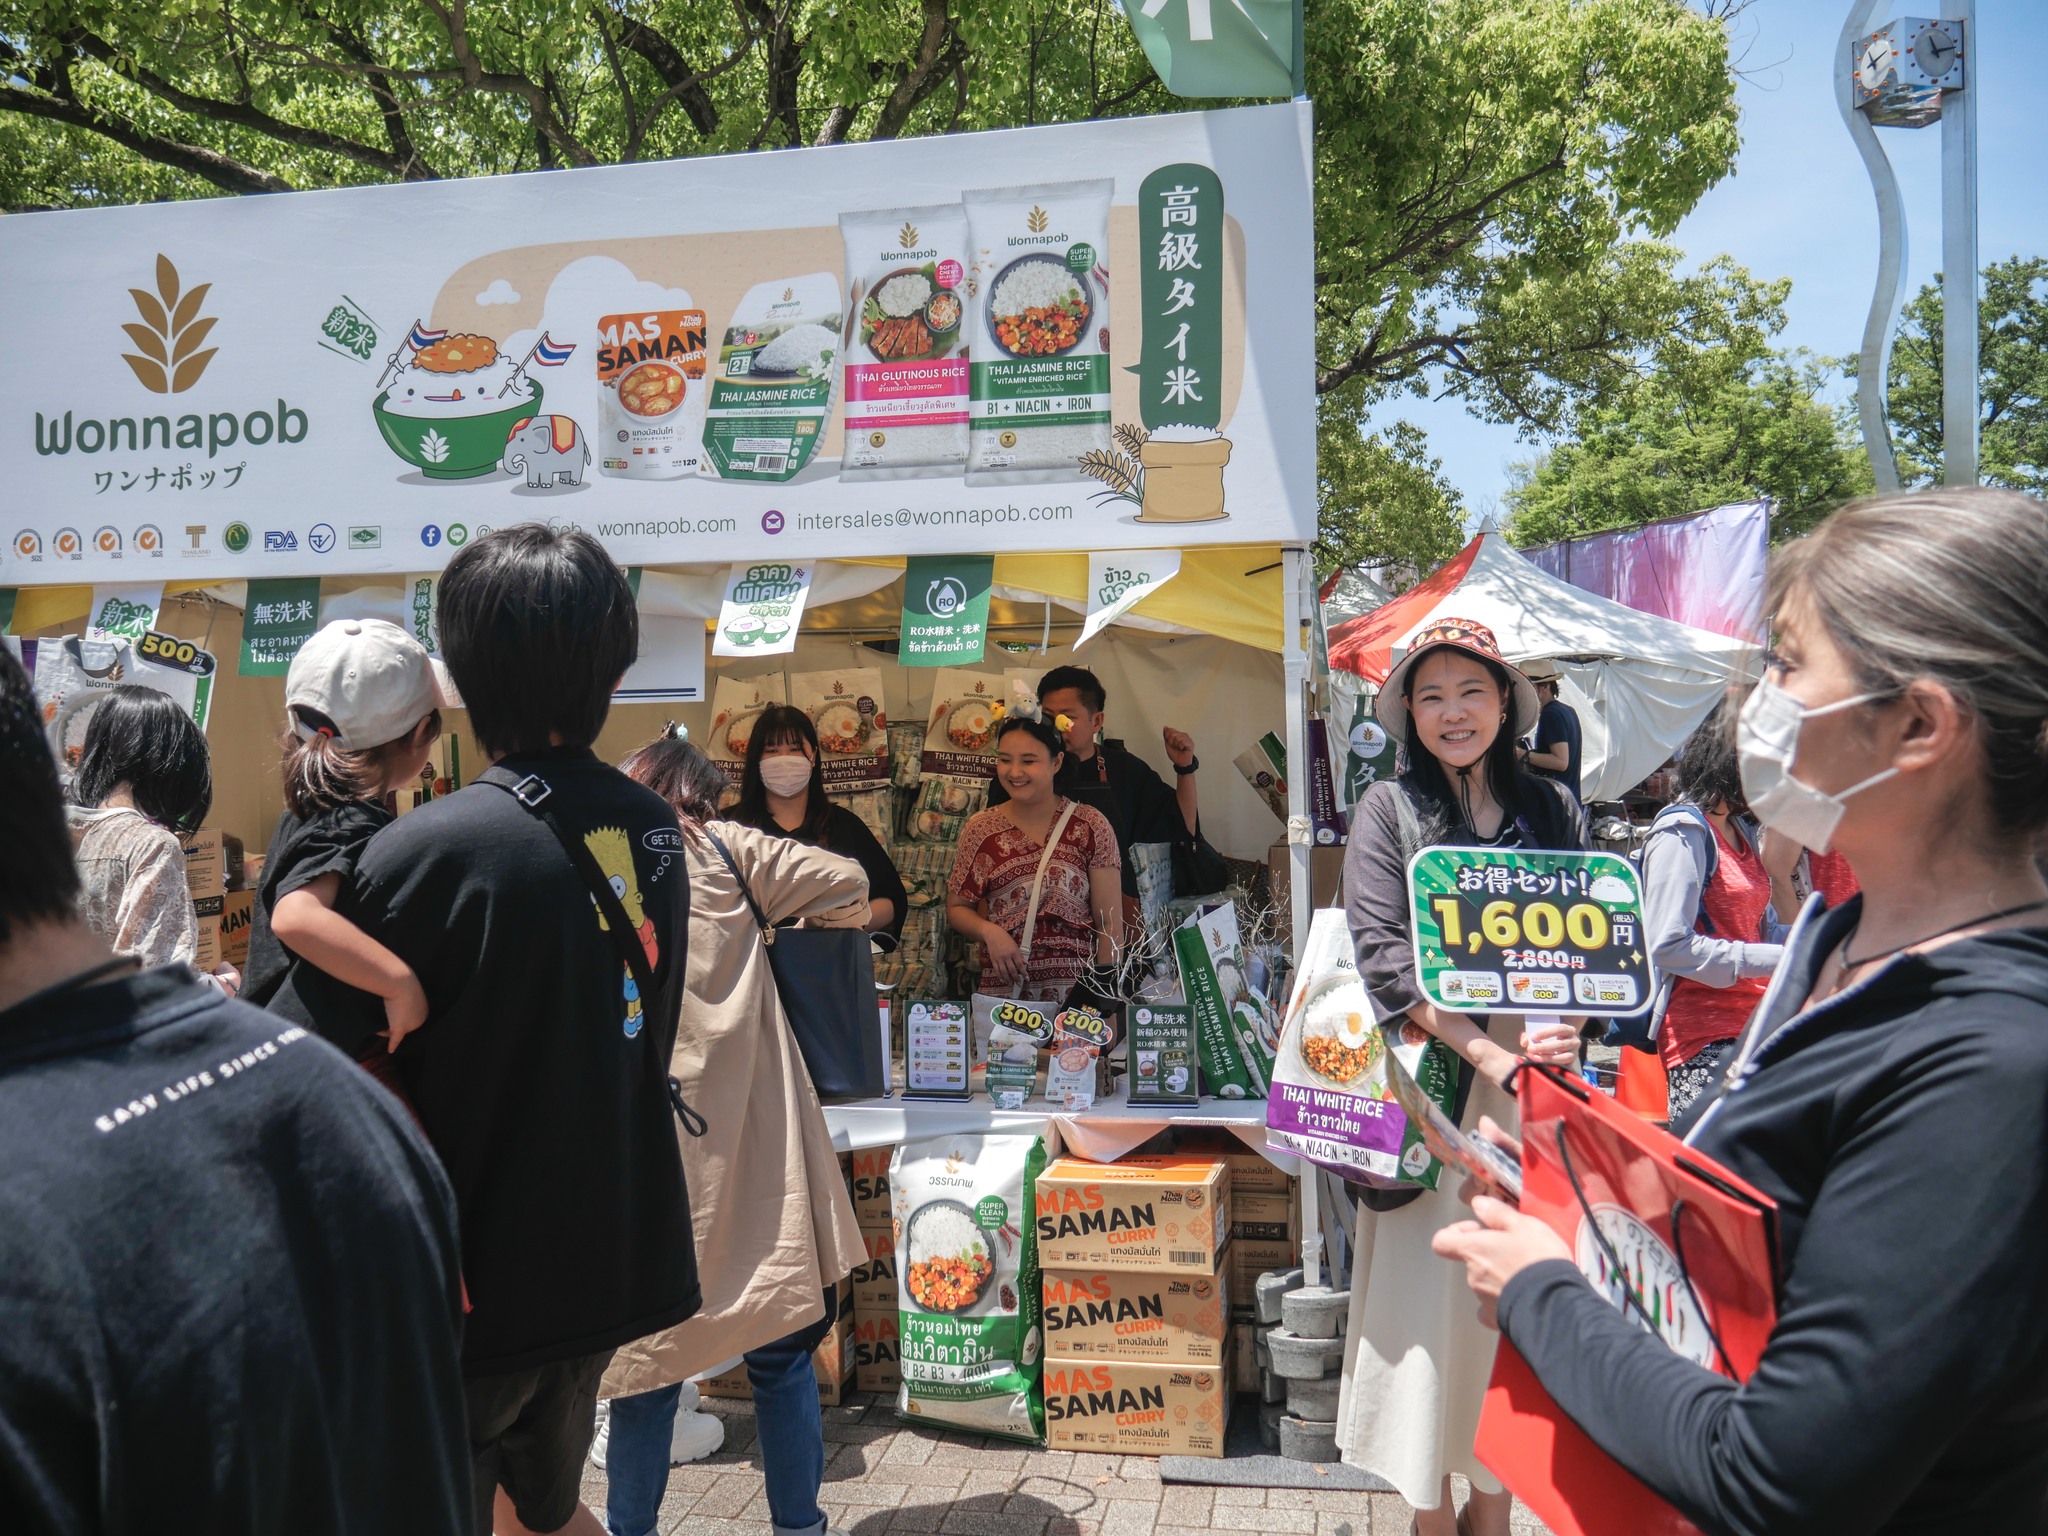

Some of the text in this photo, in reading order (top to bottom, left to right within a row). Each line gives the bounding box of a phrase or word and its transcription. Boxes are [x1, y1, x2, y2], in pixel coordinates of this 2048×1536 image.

[1007, 232, 1069, 247] Wonnapob
[880, 249, 938, 261] Wonnapob
[1069, 247, 1093, 256] SUPER
[1158, 185, 1203, 405] 高級タイ米
[321, 305, 377, 361] 新米
[597, 315, 661, 350] MAS
[597, 327, 706, 372] SAMAN
[669, 350, 706, 365] CURRY
[732, 360, 741, 372] 2
[988, 360, 1091, 376] THAI JASMINE RICE
[855, 367, 965, 383] THAI GLUTINOUS RICE
[1028, 375, 1065, 383] ENRICHED
[720, 388, 817, 403] THAI JASMINE RICE
[987, 397, 1092, 415] B1 NIACIN IRON
[36, 398, 309, 458] Wonnapob
[797, 425, 815, 434] 180g
[94, 461, 247, 495] ワンナポップ
[798, 504, 1073, 530] intersales@wonnapob.com
[598, 517, 736, 538] wonnapob.com
[264, 530, 299, 549] FDA
[748, 566, 790, 582] ราคา
[1104, 567, 1132, 584] ข้าว
[734, 583, 800, 603] พิเศษ!
[750, 605, 791, 617] お得です!
[938, 598, 955, 607] RO
[97, 599, 152, 635] 新米
[253, 600, 314, 626] 無洗米
[413, 578, 435, 654] 高級タイ米
[142, 634, 204, 666] 500 円
[966, 640, 979, 650] RO
[823, 693, 855, 701] Wonnapob
[963, 692, 994, 700] Wonnapob
[1352, 740, 1383, 748] Wonnapob
[830, 758, 878, 769] WHITE RICE
[934, 752, 999, 765] THAI WHITE RICE
[823, 768, 866, 779] ข้าวขาวไทย
[945, 763, 987, 774] ข้าวขาวไทย
[832, 781, 876, 792] NIACIN IRON
[952, 776, 972, 786] NIACIN
[651, 834, 670, 846] GET
[1458, 865, 1588, 897] お得セット!
[1434, 898, 1608, 954] 1,600
[1612, 914, 1635, 924] (税込)
[1612, 924, 1634, 946] 円
[1000, 1003, 1042, 1030] 300
[1063, 1010, 1103, 1035] 300
[1153, 1013, 1187, 1025] 無洗米
[1196, 966, 1235, 1072] THAI JASMINE RICE
[95, 1041, 279, 1133] EASY LIFE SINCE
[1283, 1085, 1384, 1119] THAI WHITE RICE
[1305, 1139, 1338, 1160] NIACIN
[1351, 1148, 1371, 1167] IRON
[854, 1152, 891, 1178] MA
[928, 1176, 974, 1188] วรรณภพ
[1036, 1184, 1104, 1216] MAS
[1164, 1190, 1183, 1199] Thai
[979, 1202, 1004, 1210] SUPER
[979, 1209, 1004, 1217] CLEAN
[1037, 1203, 1156, 1241] SAMAN
[1107, 1227, 1158, 1245] CURRY
[1110, 1245, 1161, 1257] แกงมัสมั่นไก่
[1043, 1275, 1112, 1308] MAS
[1171, 1281, 1190, 1290] Thai
[1044, 1293, 1163, 1331] SAMAN
[906, 1313, 983, 1336] ข้าวหอมไทย
[1114, 1318, 1164, 1336] CURRY
[1117, 1335, 1168, 1347] แกงมัสมั่นไก่
[913, 1363, 992, 1381] B2 B3 IRON
[1173, 1373, 1192, 1382] Thai
[1044, 1366, 1113, 1397] MAS
[965, 1386, 971, 1395] 4
[1045, 1385, 1165, 1421] SAMAN
[1115, 1410, 1166, 1427] CURRY
[1118, 1428, 1170, 1439] แกงมัสมั่นไก่
